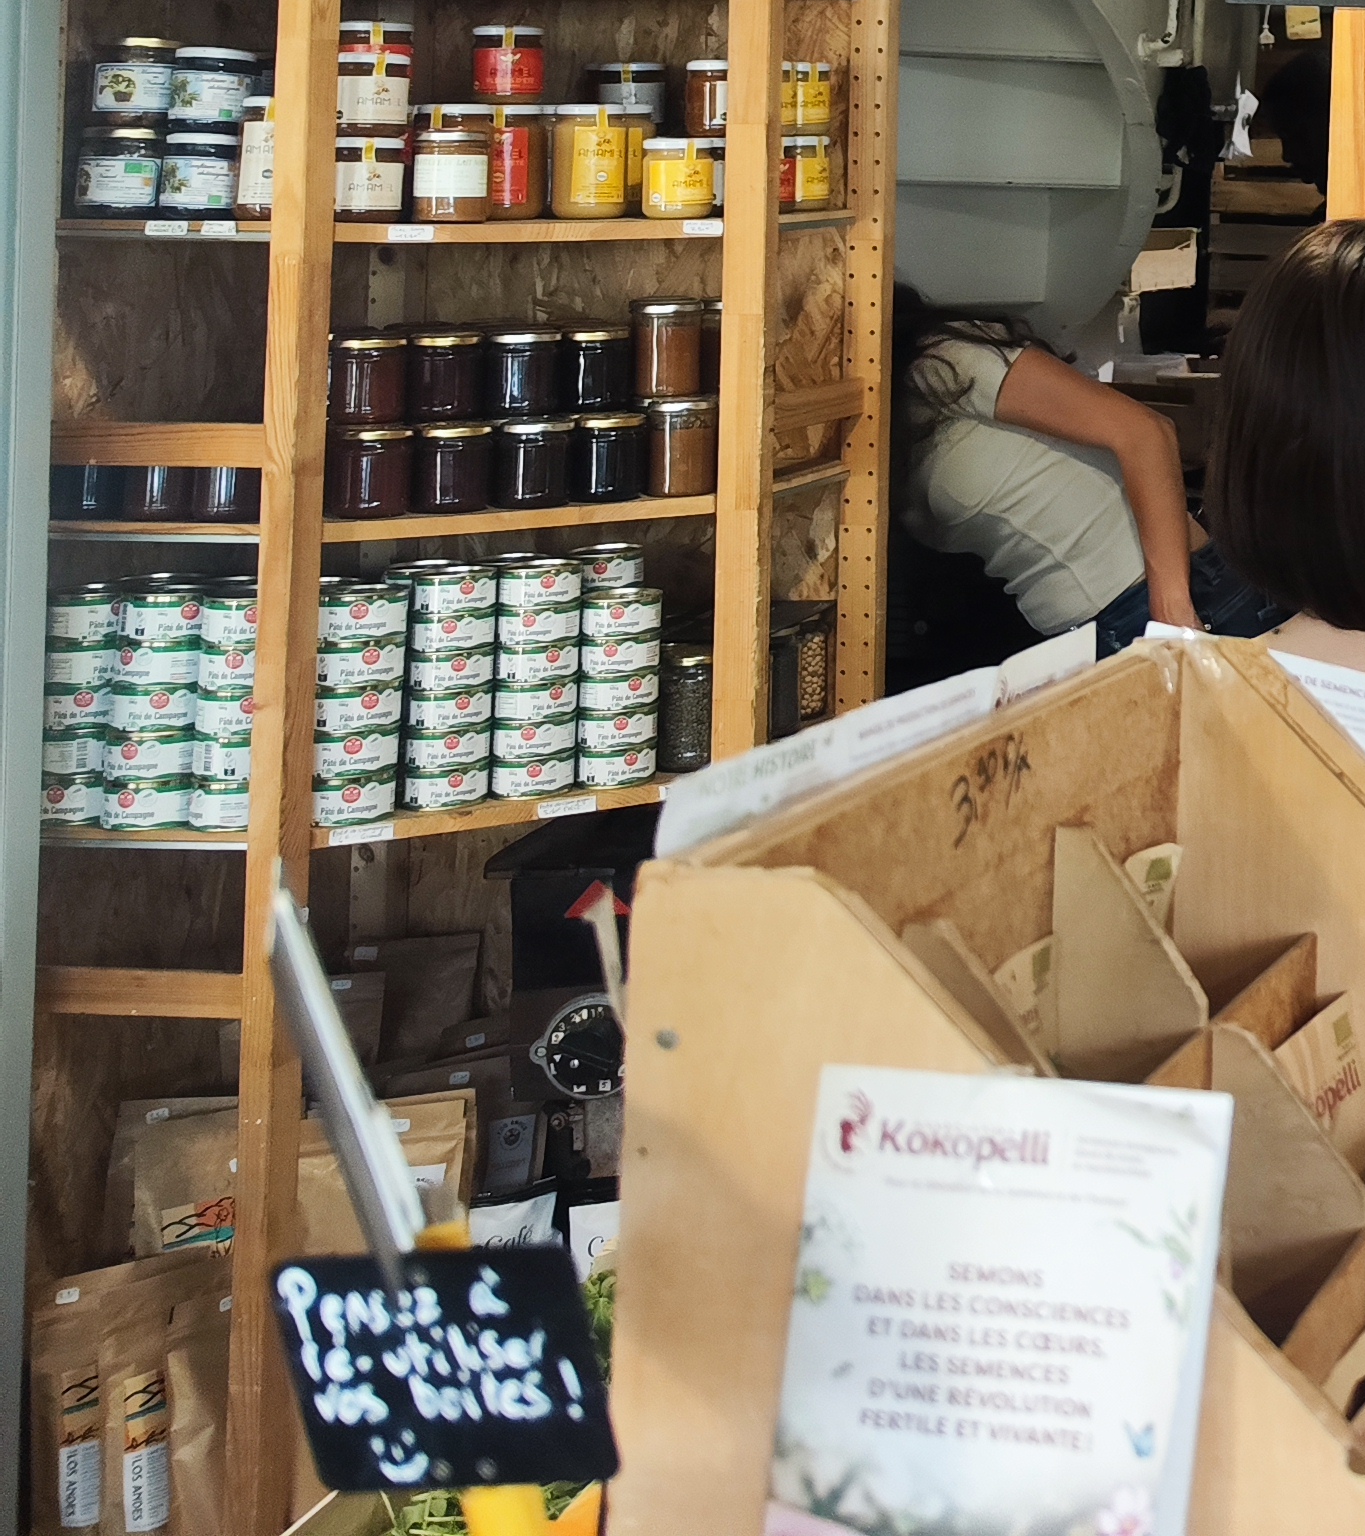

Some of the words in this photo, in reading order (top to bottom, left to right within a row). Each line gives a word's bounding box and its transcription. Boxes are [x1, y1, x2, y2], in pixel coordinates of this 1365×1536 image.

[329, 621, 344, 631] Pâté
[344, 622, 353, 631] de
[353, 620, 387, 631] Campagne
[322, 757, 338, 767] Pâté
[338, 758, 347, 766] de
[347, 754, 380, 766] Campagne
[878, 1117, 1052, 1172] Kokopelli
[947, 1261, 1044, 1289] SEMONS
[853, 1284, 918, 1311] DANS
[923, 1287, 962, 1313] LES
[968, 1295, 1132, 1329] CONSCIENCES
[867, 1315, 893, 1337] ET
[900, 1319, 962, 1345] DANS
[968, 1325, 1008, 1349] LES
[898, 1350, 940, 1374] LES
[947, 1355, 1071, 1385] SEMENCES
[868, 1377, 940, 1406] D'UNE
[947, 1380, 1092, 1419] RÉVOLUTION
[860, 1408, 948, 1437] FERTILE
[955, 1418, 981, 1439] ET
[989, 1420, 1085, 1451] VIVANTE
[131, 1458, 143, 1482] LOS
[131, 1485, 143, 1522] ANDES
